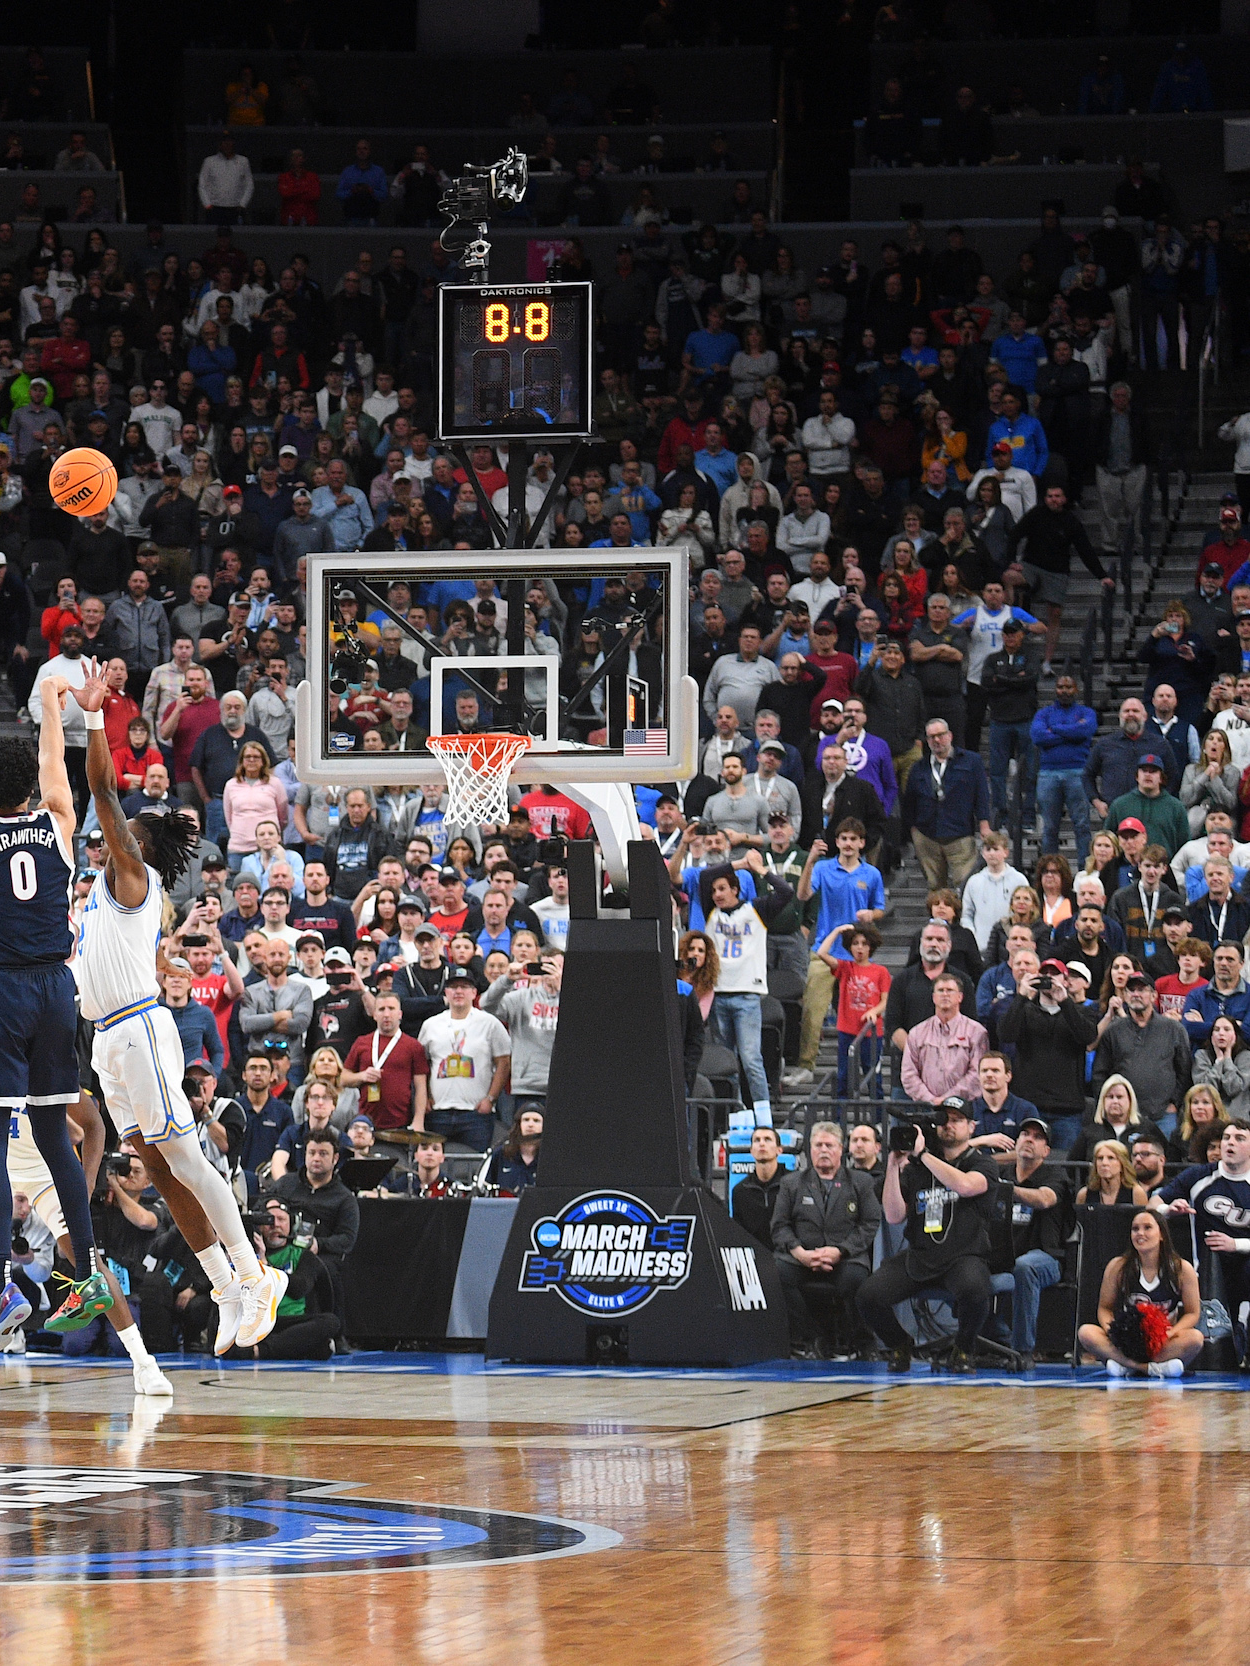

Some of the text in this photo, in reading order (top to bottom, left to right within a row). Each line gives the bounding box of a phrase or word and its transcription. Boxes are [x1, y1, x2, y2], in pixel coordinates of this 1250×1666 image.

[479, 287, 553, 298] DAKTRONICS
[979, 623, 1004, 634] UCL
[989, 633, 996, 648] 1
[10, 850, 38, 901] 0
[714, 922, 753, 937] UCLA
[722, 940, 743, 959] 16
[190, 987, 219, 1001] NLV
[582, 1198, 629, 1214] SWEET 16
[561, 1223, 648, 1251] MARCH
[570, 1250, 688, 1277] MADNESS
[588, 1295, 618, 1309] ELITE
